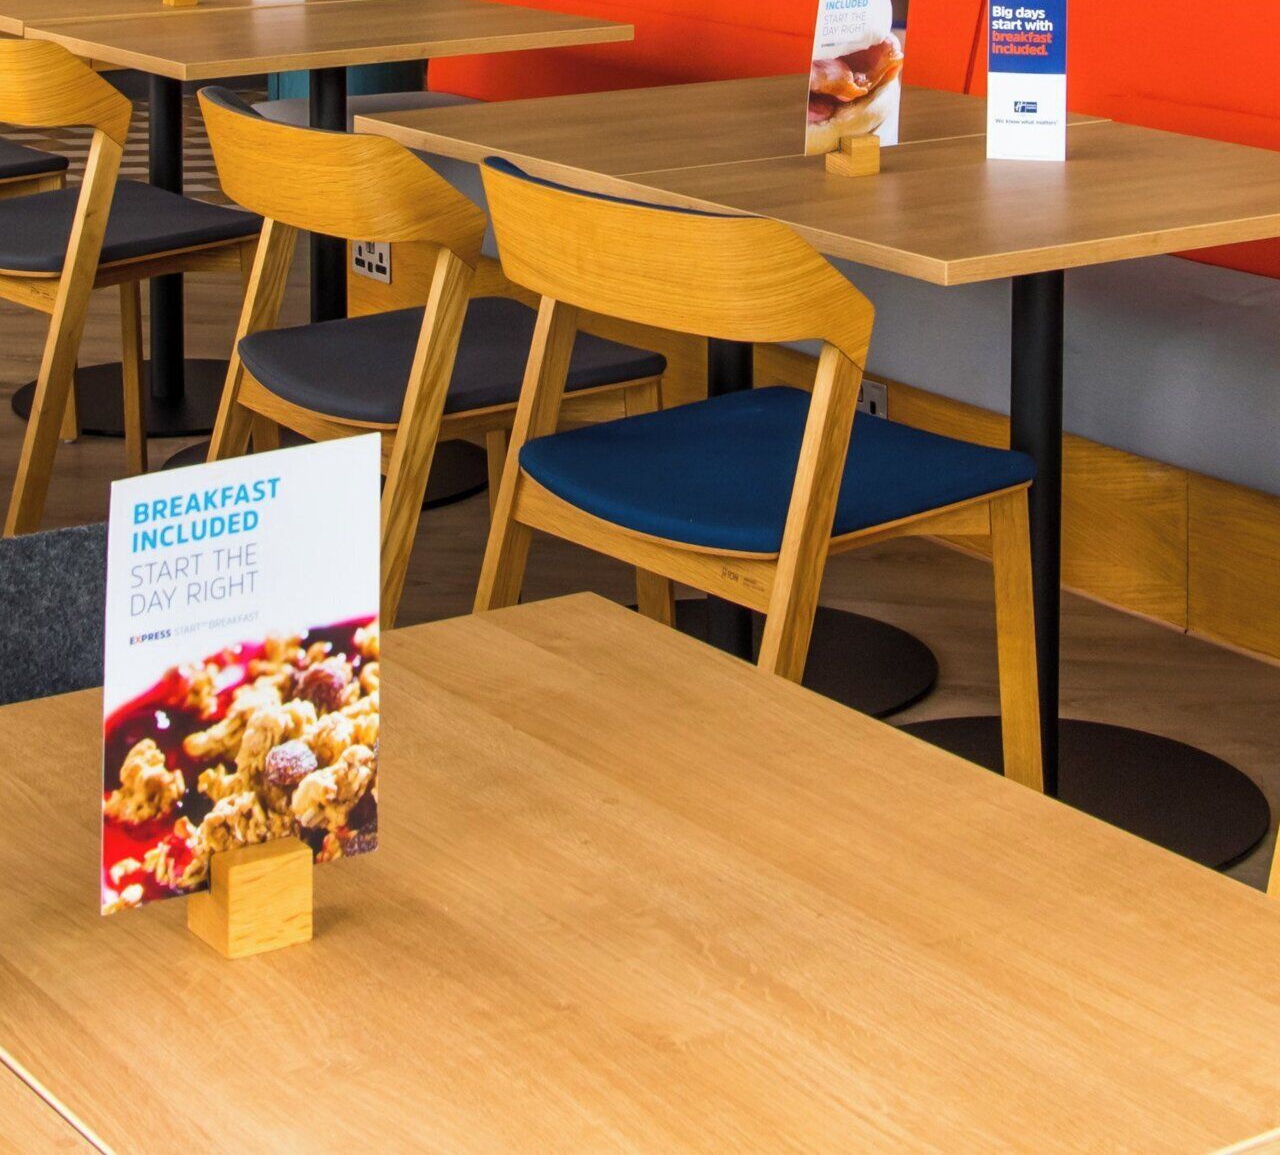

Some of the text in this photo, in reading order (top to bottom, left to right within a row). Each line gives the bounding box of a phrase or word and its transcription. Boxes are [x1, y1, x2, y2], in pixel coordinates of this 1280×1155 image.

[823, 11, 867, 25] START THE
[992, 5, 1046, 21] Big days
[822, 22, 867, 37] DAY RIGHT
[991, 19, 1054, 32] start with
[991, 31, 1053, 44] breakfast
[991, 43, 1049, 56] included.
[133, 476, 282, 525] BREAKFAST
[132, 509, 260, 553] INCLUDED
[130, 542, 258, 589] START THE
[130, 570, 260, 617] DAY RIGHT
[129, 629, 172, 645] EXPRESS
